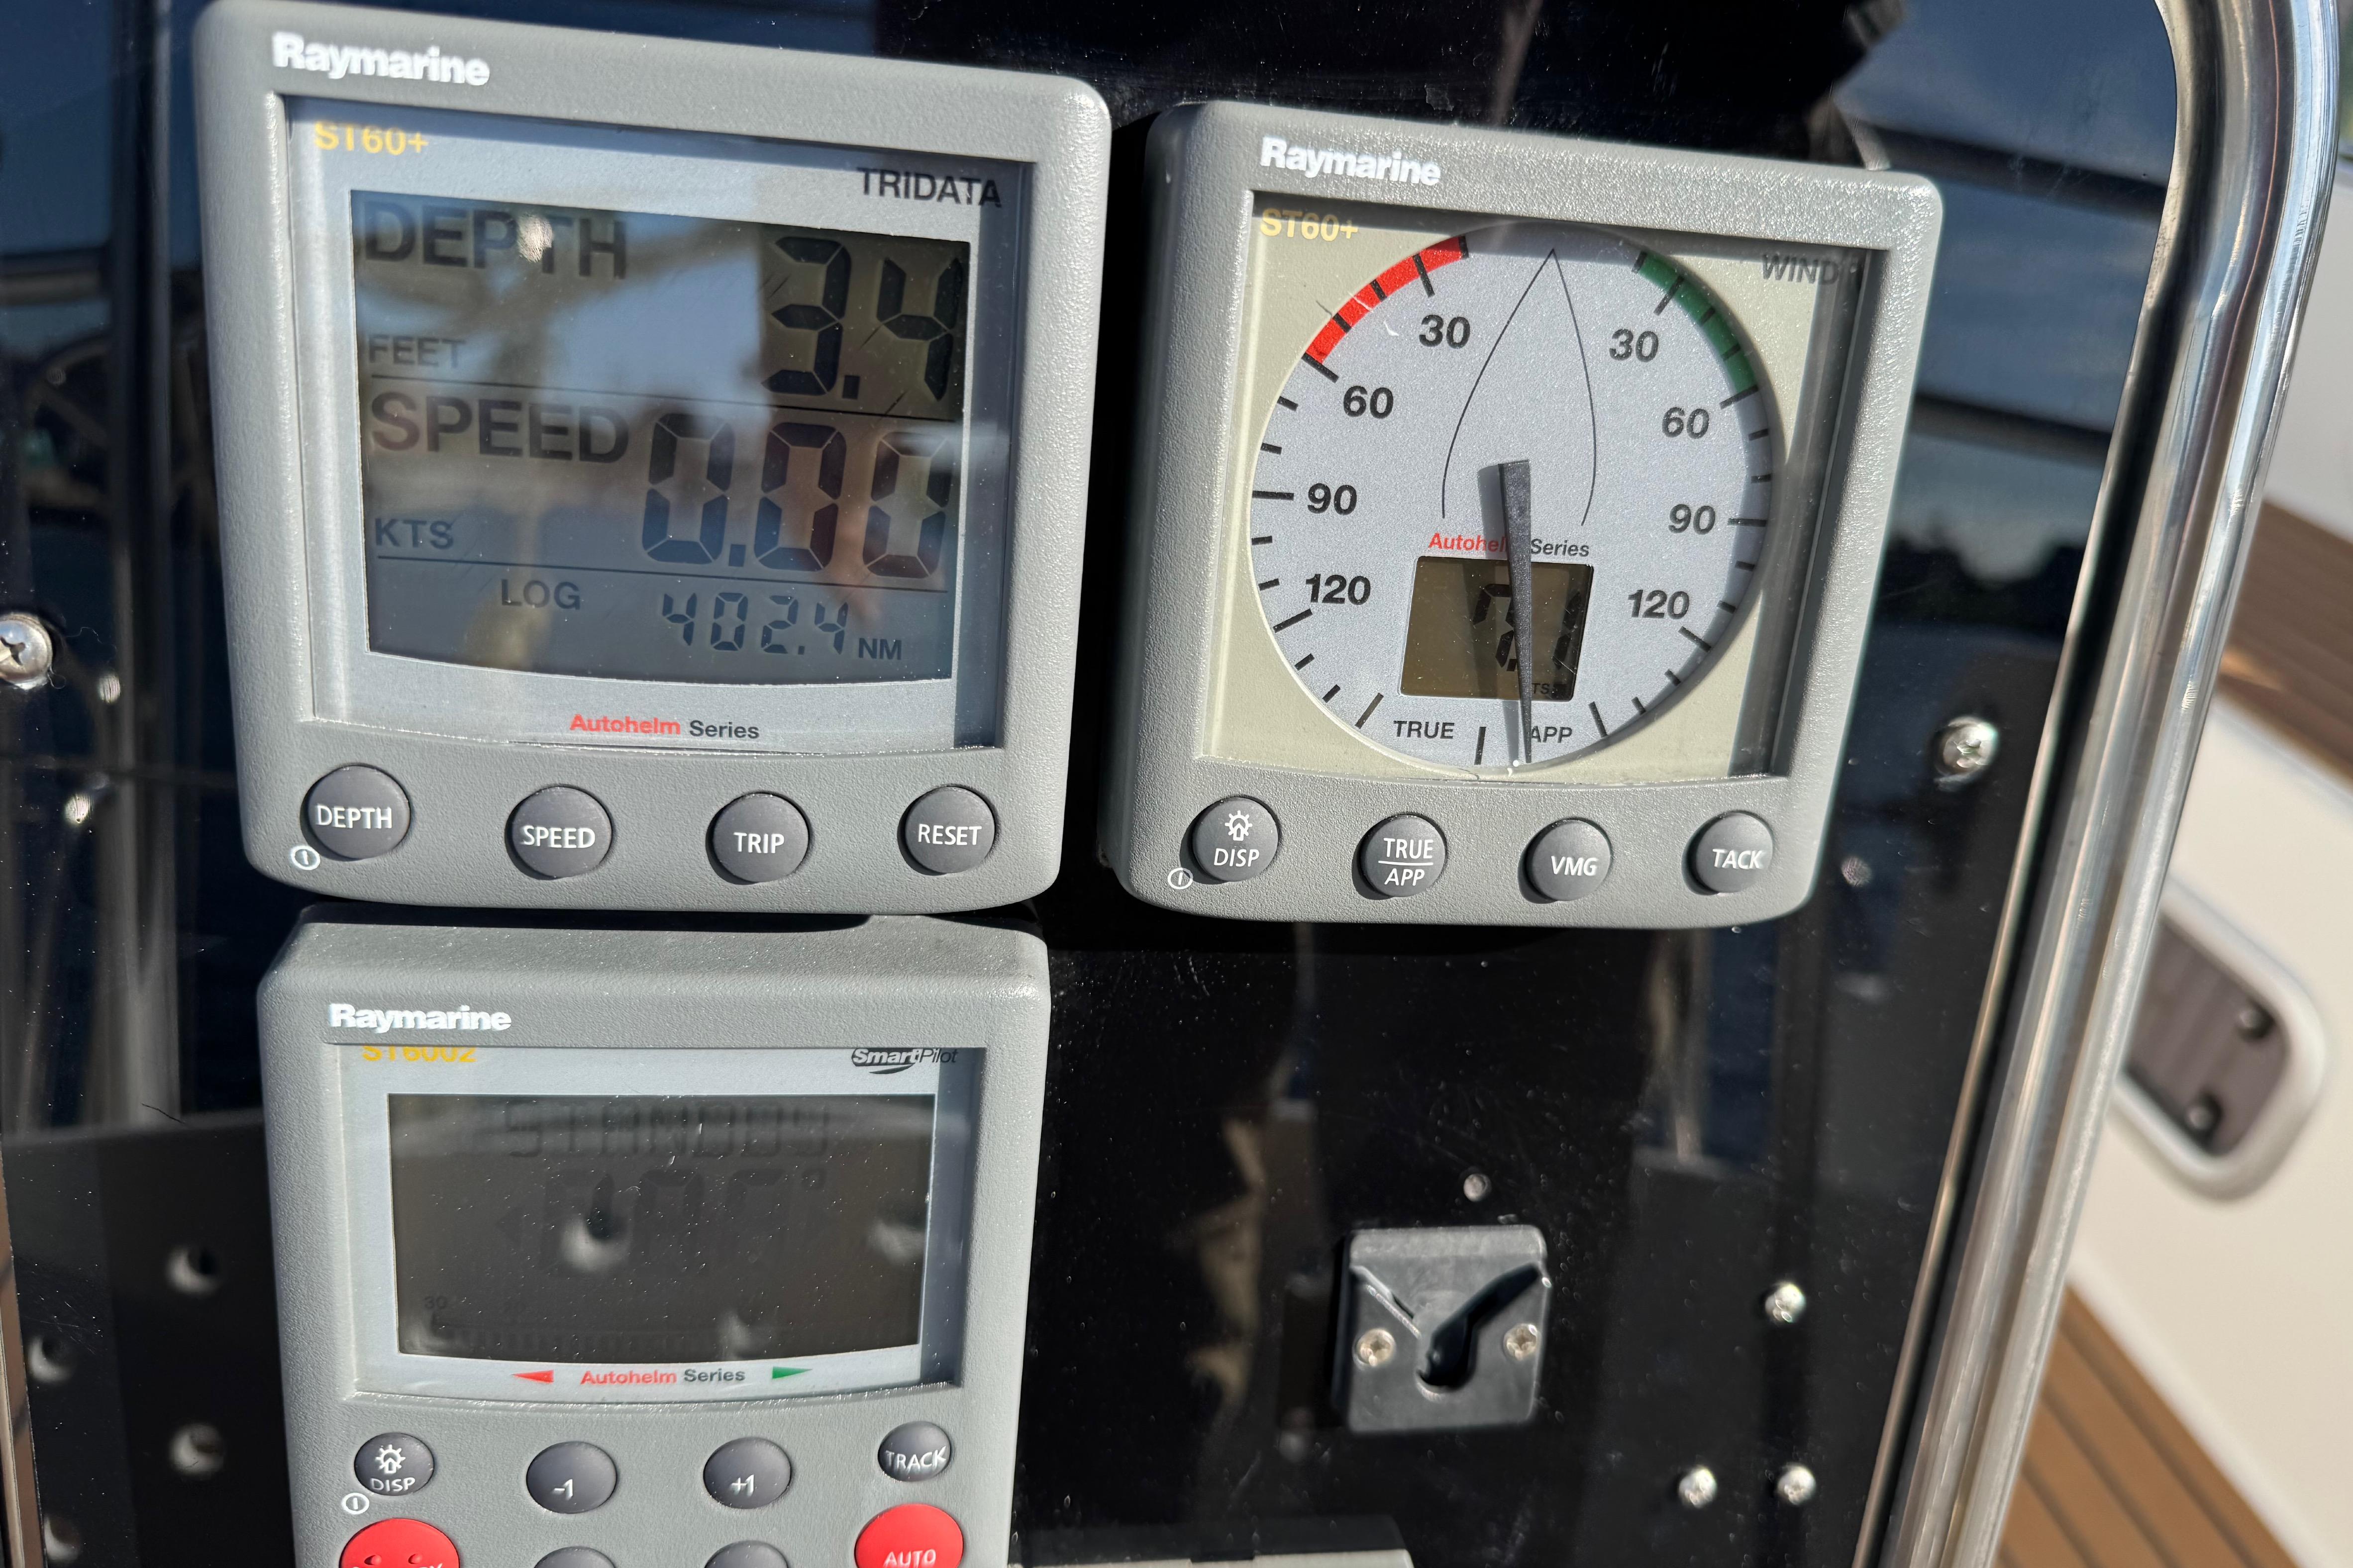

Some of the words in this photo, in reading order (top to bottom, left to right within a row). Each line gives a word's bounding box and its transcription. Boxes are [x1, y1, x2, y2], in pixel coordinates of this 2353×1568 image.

[272, 31, 490, 86] Raymarine
[314, 121, 428, 155] ST60+
[1260, 136, 1441, 186] Raymarine
[857, 167, 1002, 207] TRIDATA
[1260, 208, 1358, 241] ST60+
[364, 203, 626, 279] DEPTH
[1761, 255, 1839, 286] WIND
[762, 236, 963, 401] 3.4
[1419, 315, 1470, 348] 30
[369, 334, 466, 368] FEET
[1609, 329, 1658, 362] 30
[1343, 386, 1393, 419] 60
[371, 392, 629, 464] SPEED
[1661, 407, 1710, 439] 60
[642, 413, 952, 579] 0.00
[1308, 483, 1357, 515] 90
[375, 518, 453, 549] KTS
[1668, 504, 1715, 535] 90
[1429, 532, 1507, 553] Autohel
[1531, 539, 1589, 556] Series
[1306, 574, 1371, 605] 120
[1628, 589, 1690, 620] 120
[501, 579, 580, 610] LOG
[662, 592, 848, 655] 402.4
[858, 637, 902, 660] NM
[570, 714, 681, 736] Autohelm
[690, 720, 759, 739] Series
[1394, 720, 1454, 739] TRUE
[1530, 726, 1572, 743] APP
[316, 804, 392, 829] DEPTH
[522, 825, 595, 848] SPEED
[733, 832, 785, 854] TRIP
[918, 824, 982, 846] RESET
[1383, 838, 1433, 859] TRUE
[1214, 848, 1259, 867] DISP
[1551, 856, 1598, 877] VMG
[1712, 849, 1763, 870] TACK
[1384, 869, 1425, 886] APP
[328, 1003, 512, 1033] Raymarine
[580, 1369, 677, 1385] Autohelm
[683, 1368, 746, 1383] Series
[885, 1446, 947, 1471] TRACK
[370, 1477, 415, 1492] DISP
[554, 1479, 573, 1499] -1
[731, 1474, 755, 1495] +1
[883, 1549, 936, 1568] AUTO
